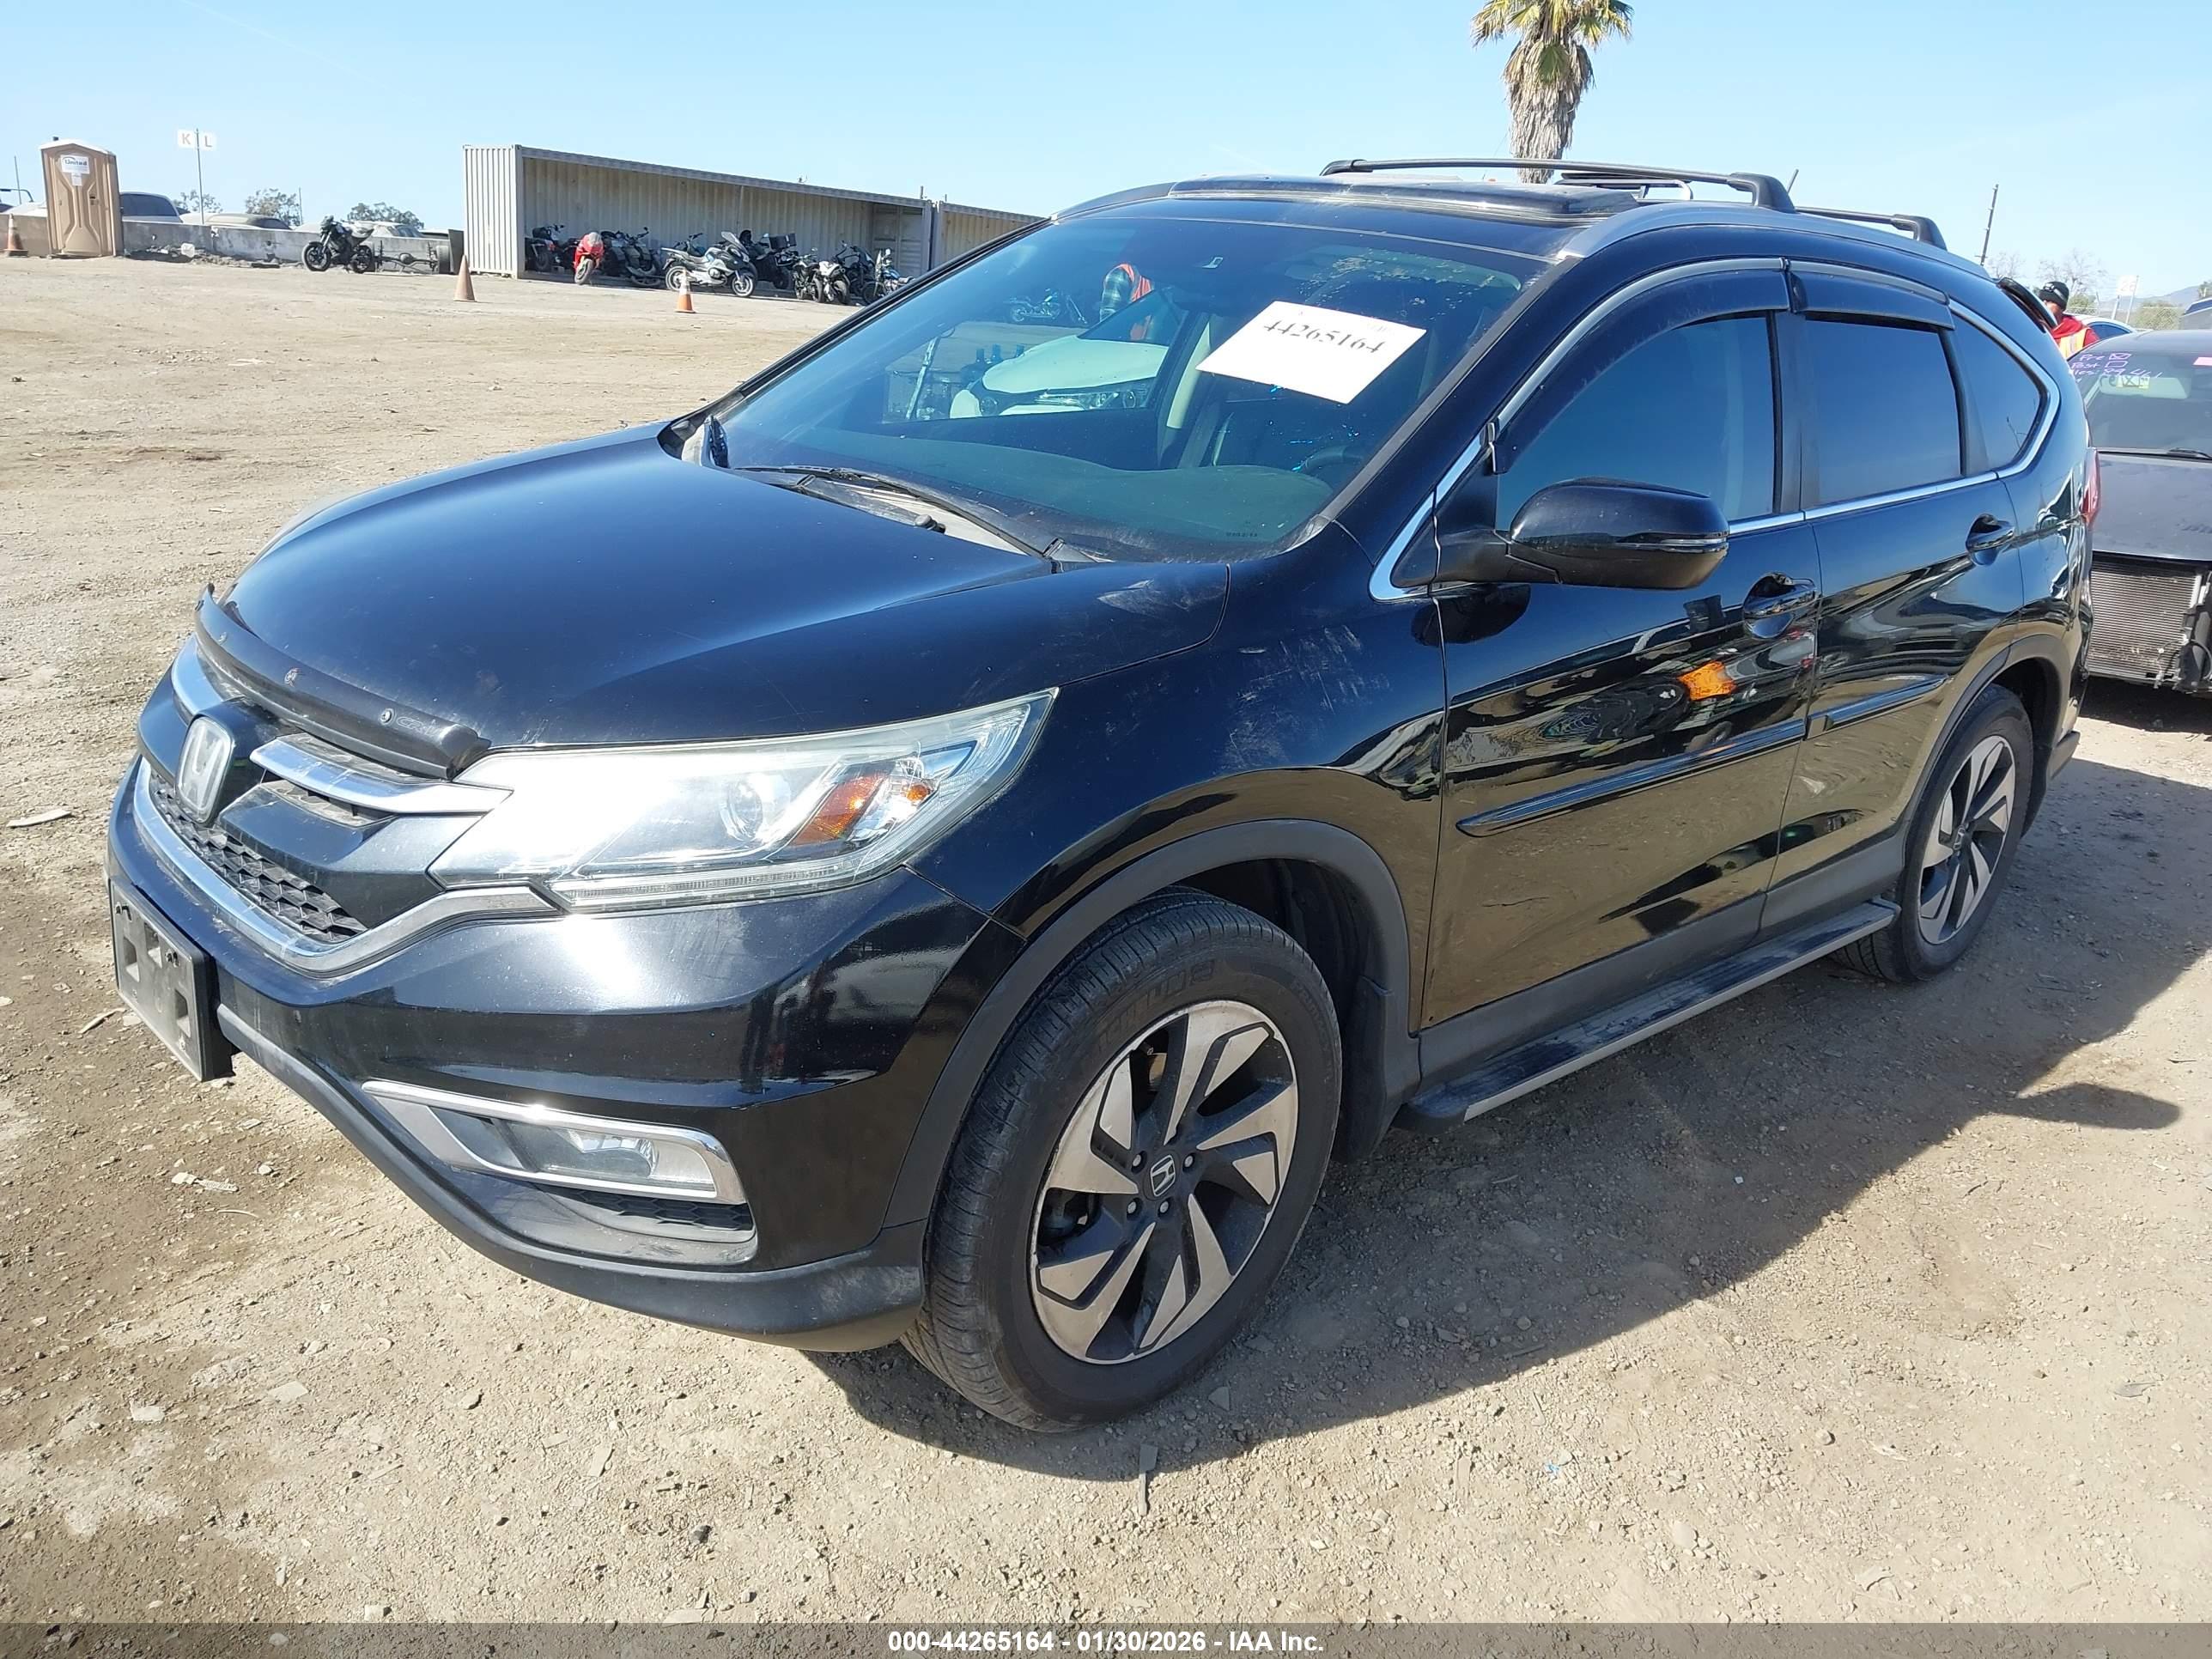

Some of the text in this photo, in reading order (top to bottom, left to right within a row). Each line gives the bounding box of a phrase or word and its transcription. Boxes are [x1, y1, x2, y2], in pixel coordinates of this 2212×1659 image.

[181, 133, 191, 145] K
[204, 136, 213, 148] L
[1263, 319, 1386, 354] 44265164
